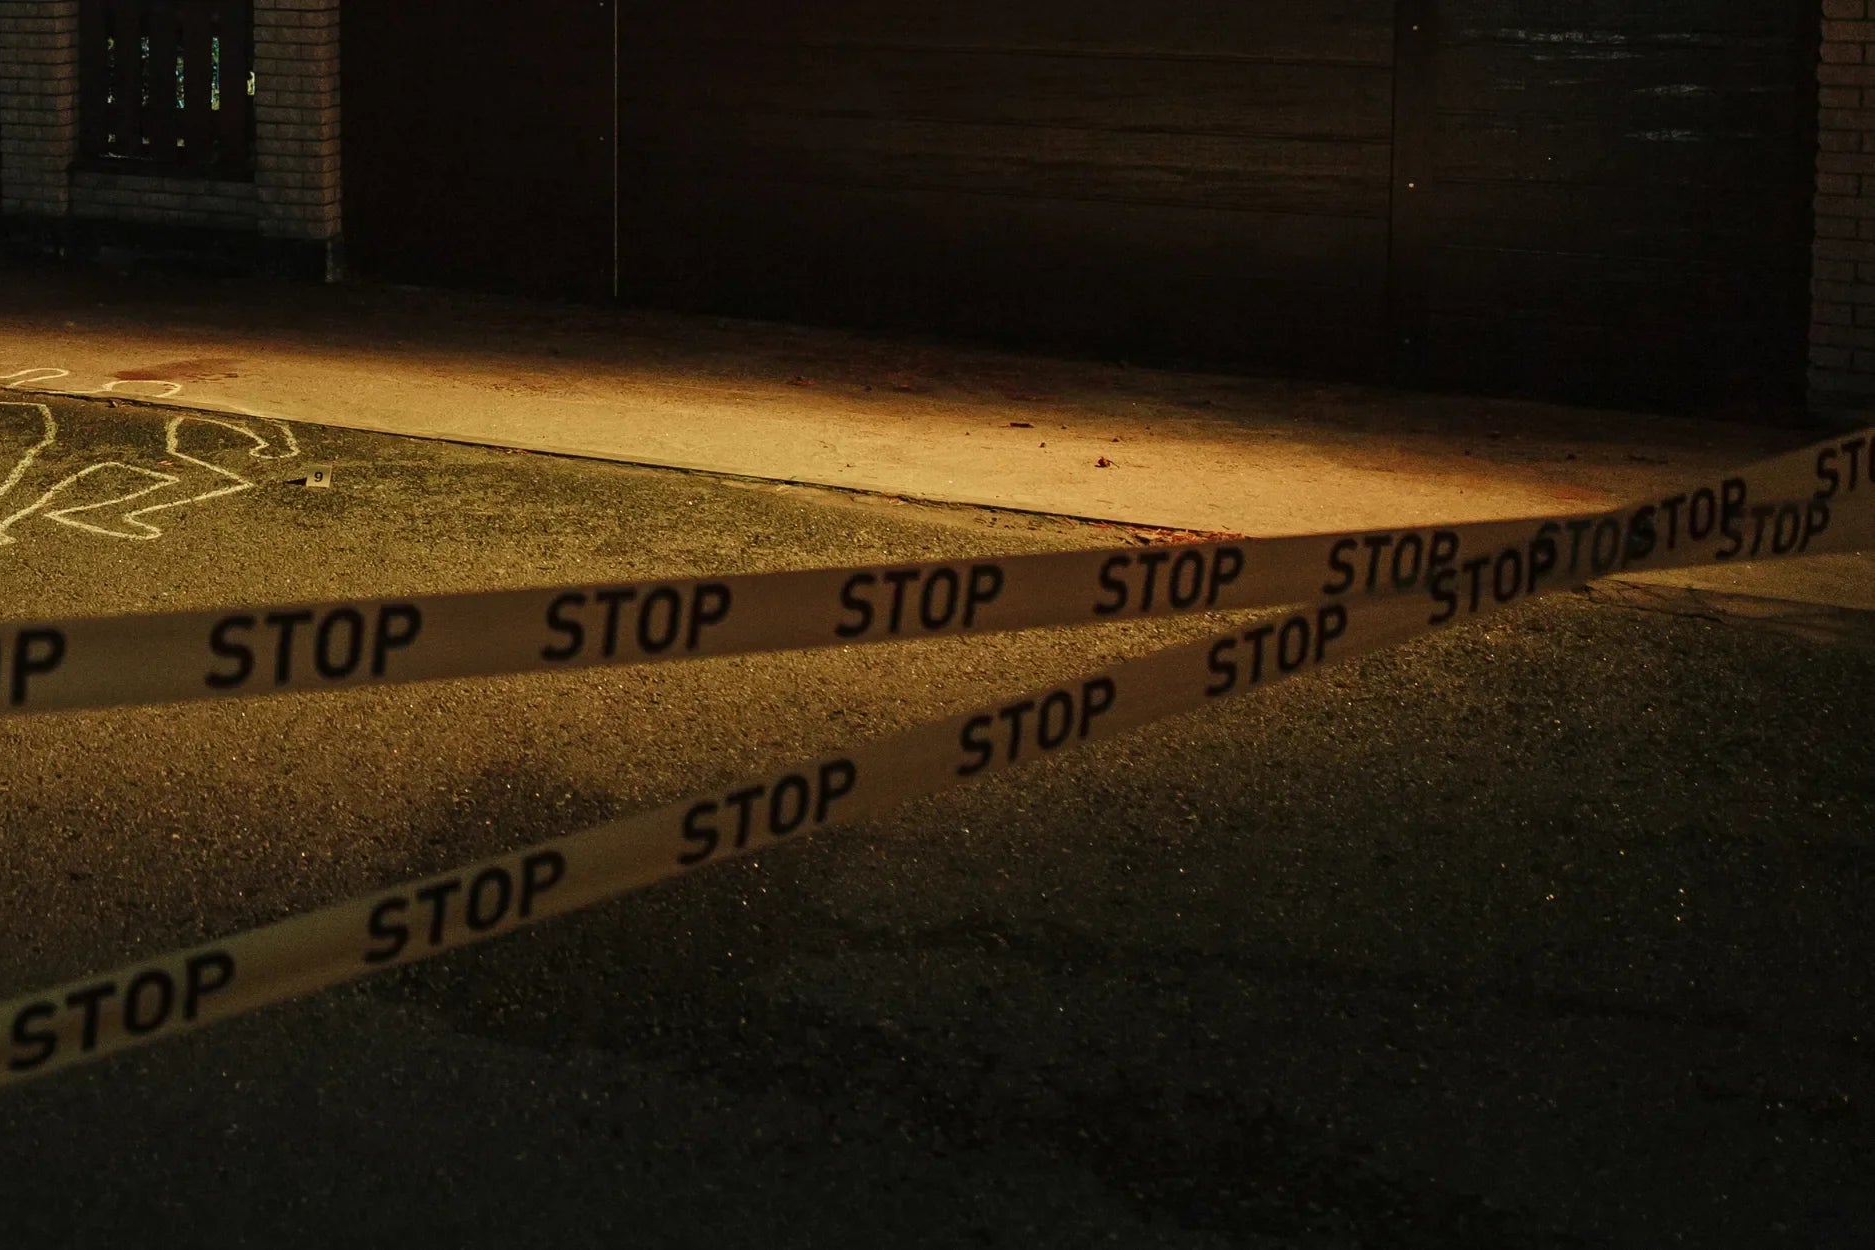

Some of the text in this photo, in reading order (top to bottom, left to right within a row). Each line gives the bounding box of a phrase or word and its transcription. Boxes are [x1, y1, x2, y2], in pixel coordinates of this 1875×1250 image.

[314, 471, 323, 482] 9
[205, 604, 422, 689] STOP
[542, 583, 731, 661] STOP
[836, 564, 1003, 638] STOP
[1094, 547, 1243, 614] STOP
[1322, 530, 1459, 595] STOP
[8, 949, 236, 1072] STOP
[364, 851, 565, 964] STOP
[678, 759, 857, 867] STOP
[957, 676, 1117, 777] STOP
[1205, 604, 1347, 698] STOP
[1428, 538, 1556, 625] STOP
[1628, 477, 1746, 560] STOP
[1813, 437, 1875, 499] ST
